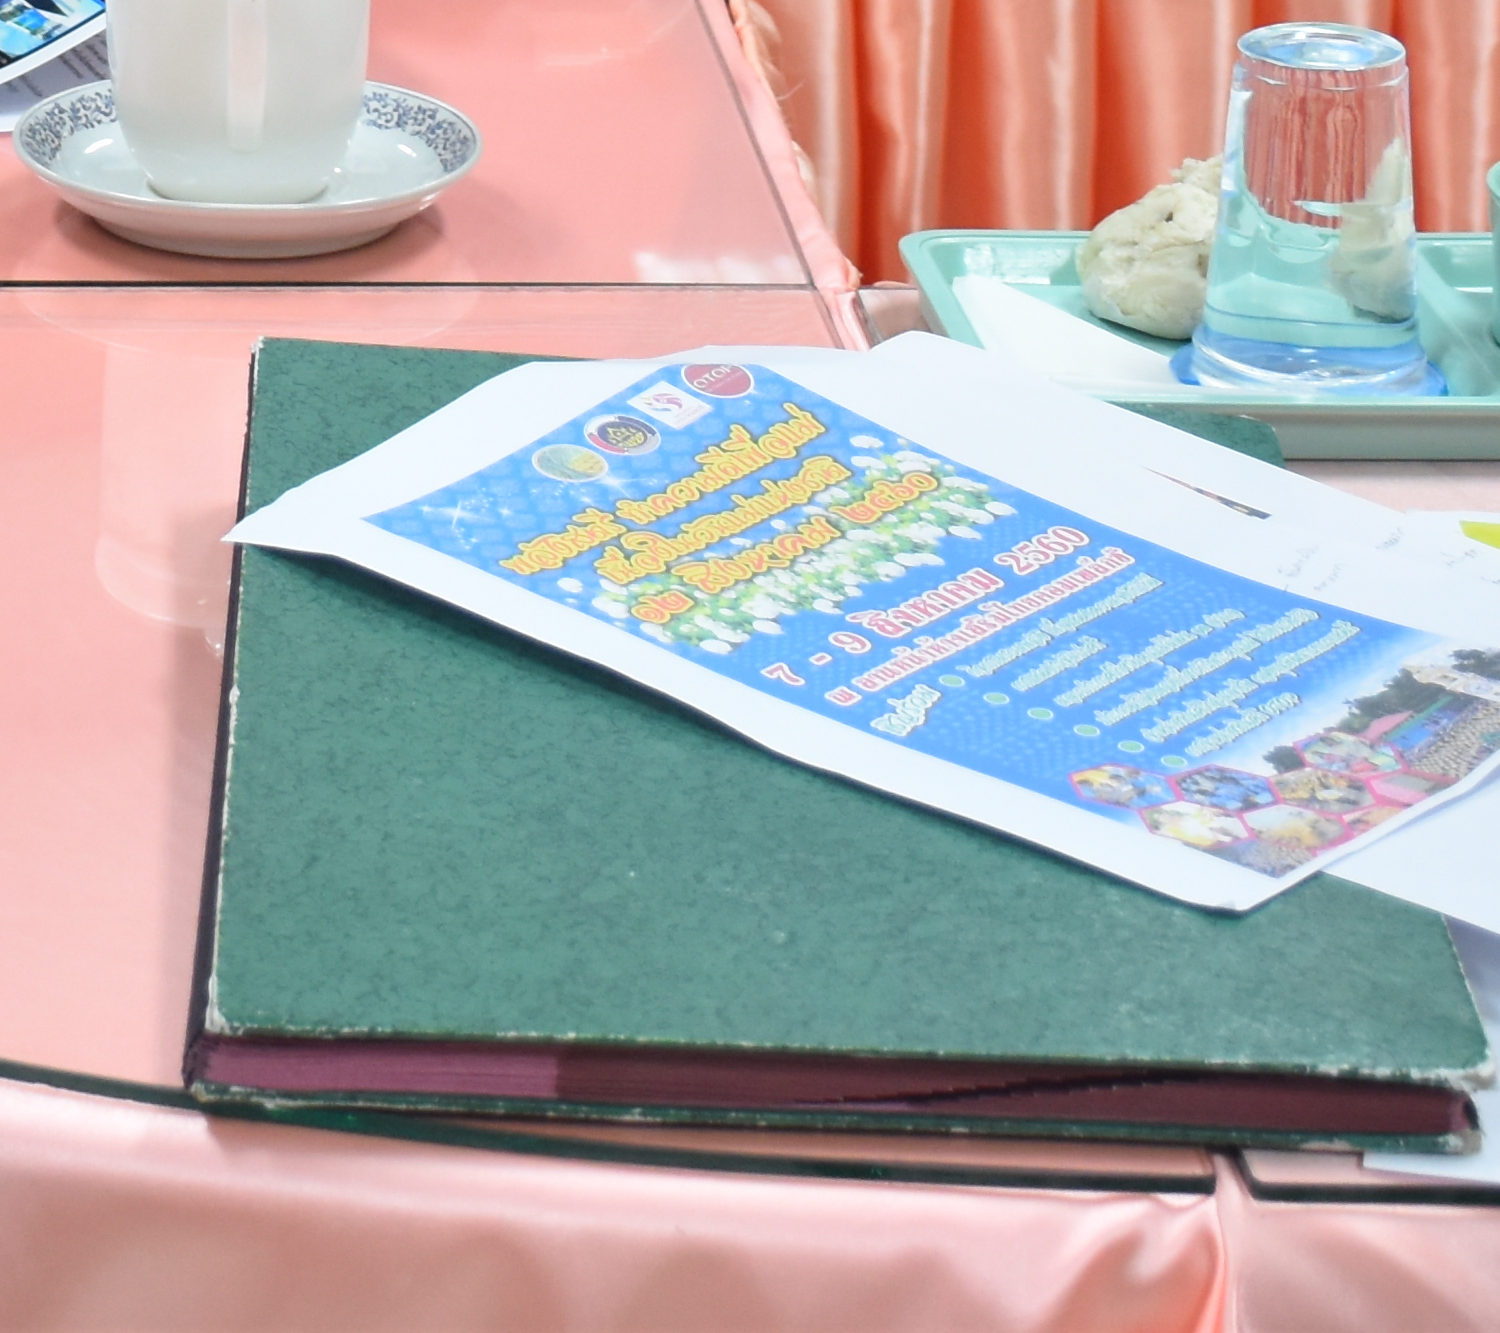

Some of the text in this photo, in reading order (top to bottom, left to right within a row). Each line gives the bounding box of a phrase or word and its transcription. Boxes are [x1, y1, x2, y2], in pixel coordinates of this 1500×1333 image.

[499, 403, 829, 575] พลังสตรี ทำความดีเพื่อแม่
[594, 456, 853, 585] เนื่องในวันแม่แห่งชาติ
[630, 471, 941, 625] ๑๒ สิงหาคม ๒๕๖๐
[993, 524, 1093, 576] 2560
[844, 564, 1007, 641] สิงหาคม
[760, 662, 806, 688] 7
[826, 630, 874, 657] 9
[823, 686, 859, 707] ณ
